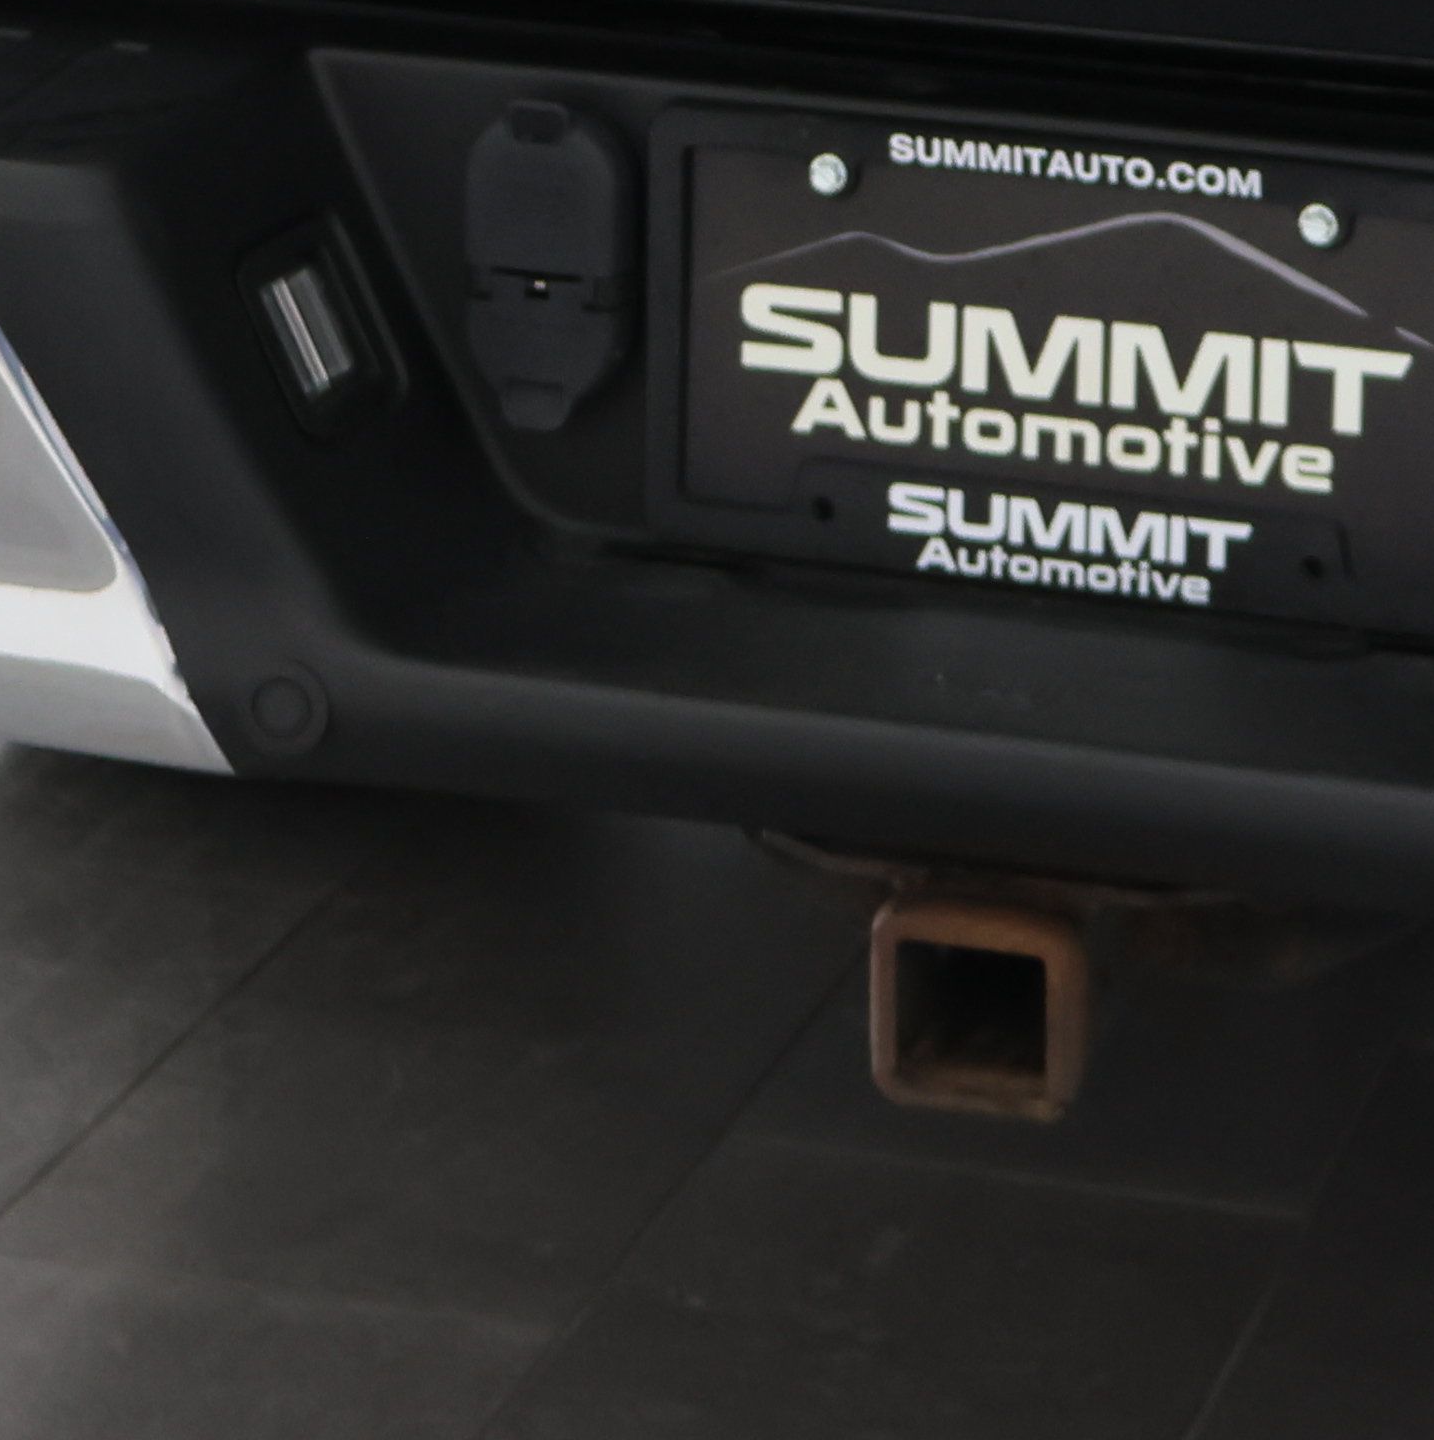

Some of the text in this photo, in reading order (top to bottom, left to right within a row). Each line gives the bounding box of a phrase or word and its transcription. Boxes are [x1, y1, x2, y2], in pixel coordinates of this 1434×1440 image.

[888, 132, 1264, 200] SUMMITAUTO.COM
[739, 282, 1414, 436] SUMMIT
[790, 378, 1336, 494] Automotive
[886, 481, 1253, 570] SUMMIT
[916, 536, 1212, 606] Automotive
